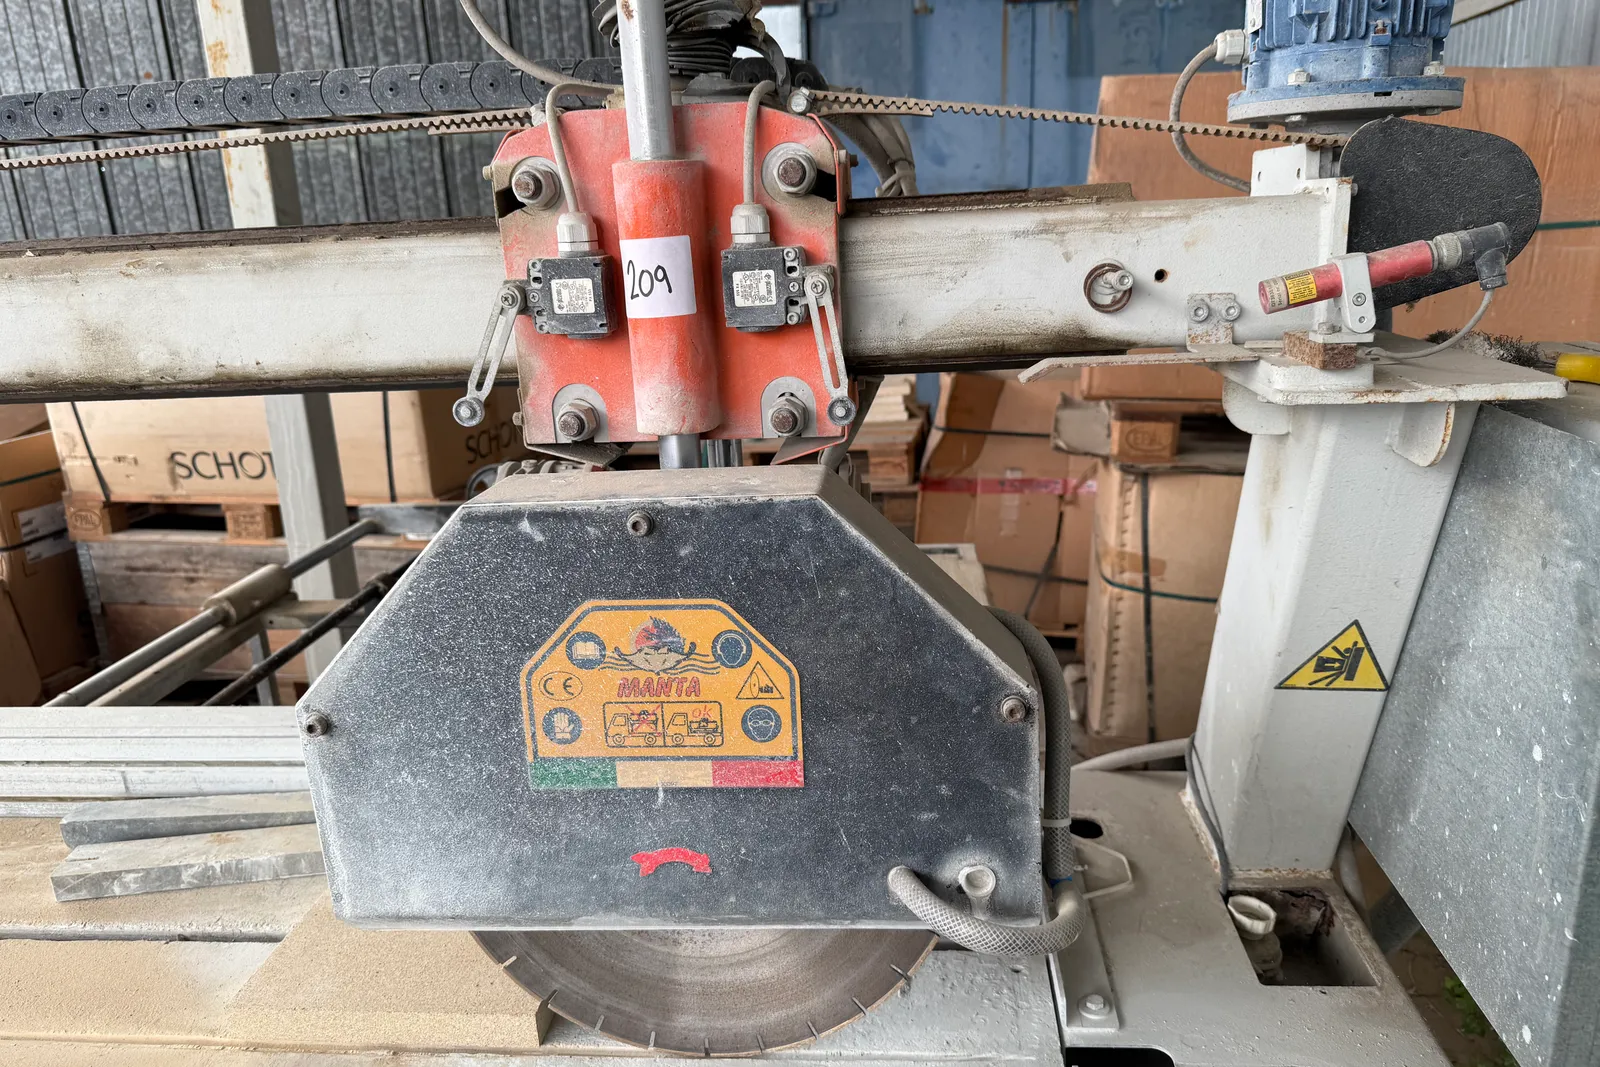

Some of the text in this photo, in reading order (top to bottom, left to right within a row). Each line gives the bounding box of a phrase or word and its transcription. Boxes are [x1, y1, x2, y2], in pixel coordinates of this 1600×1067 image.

[627, 259, 673, 300] 209
[543, 676, 574, 696] CE
[617, 676, 701, 698] MANTA
